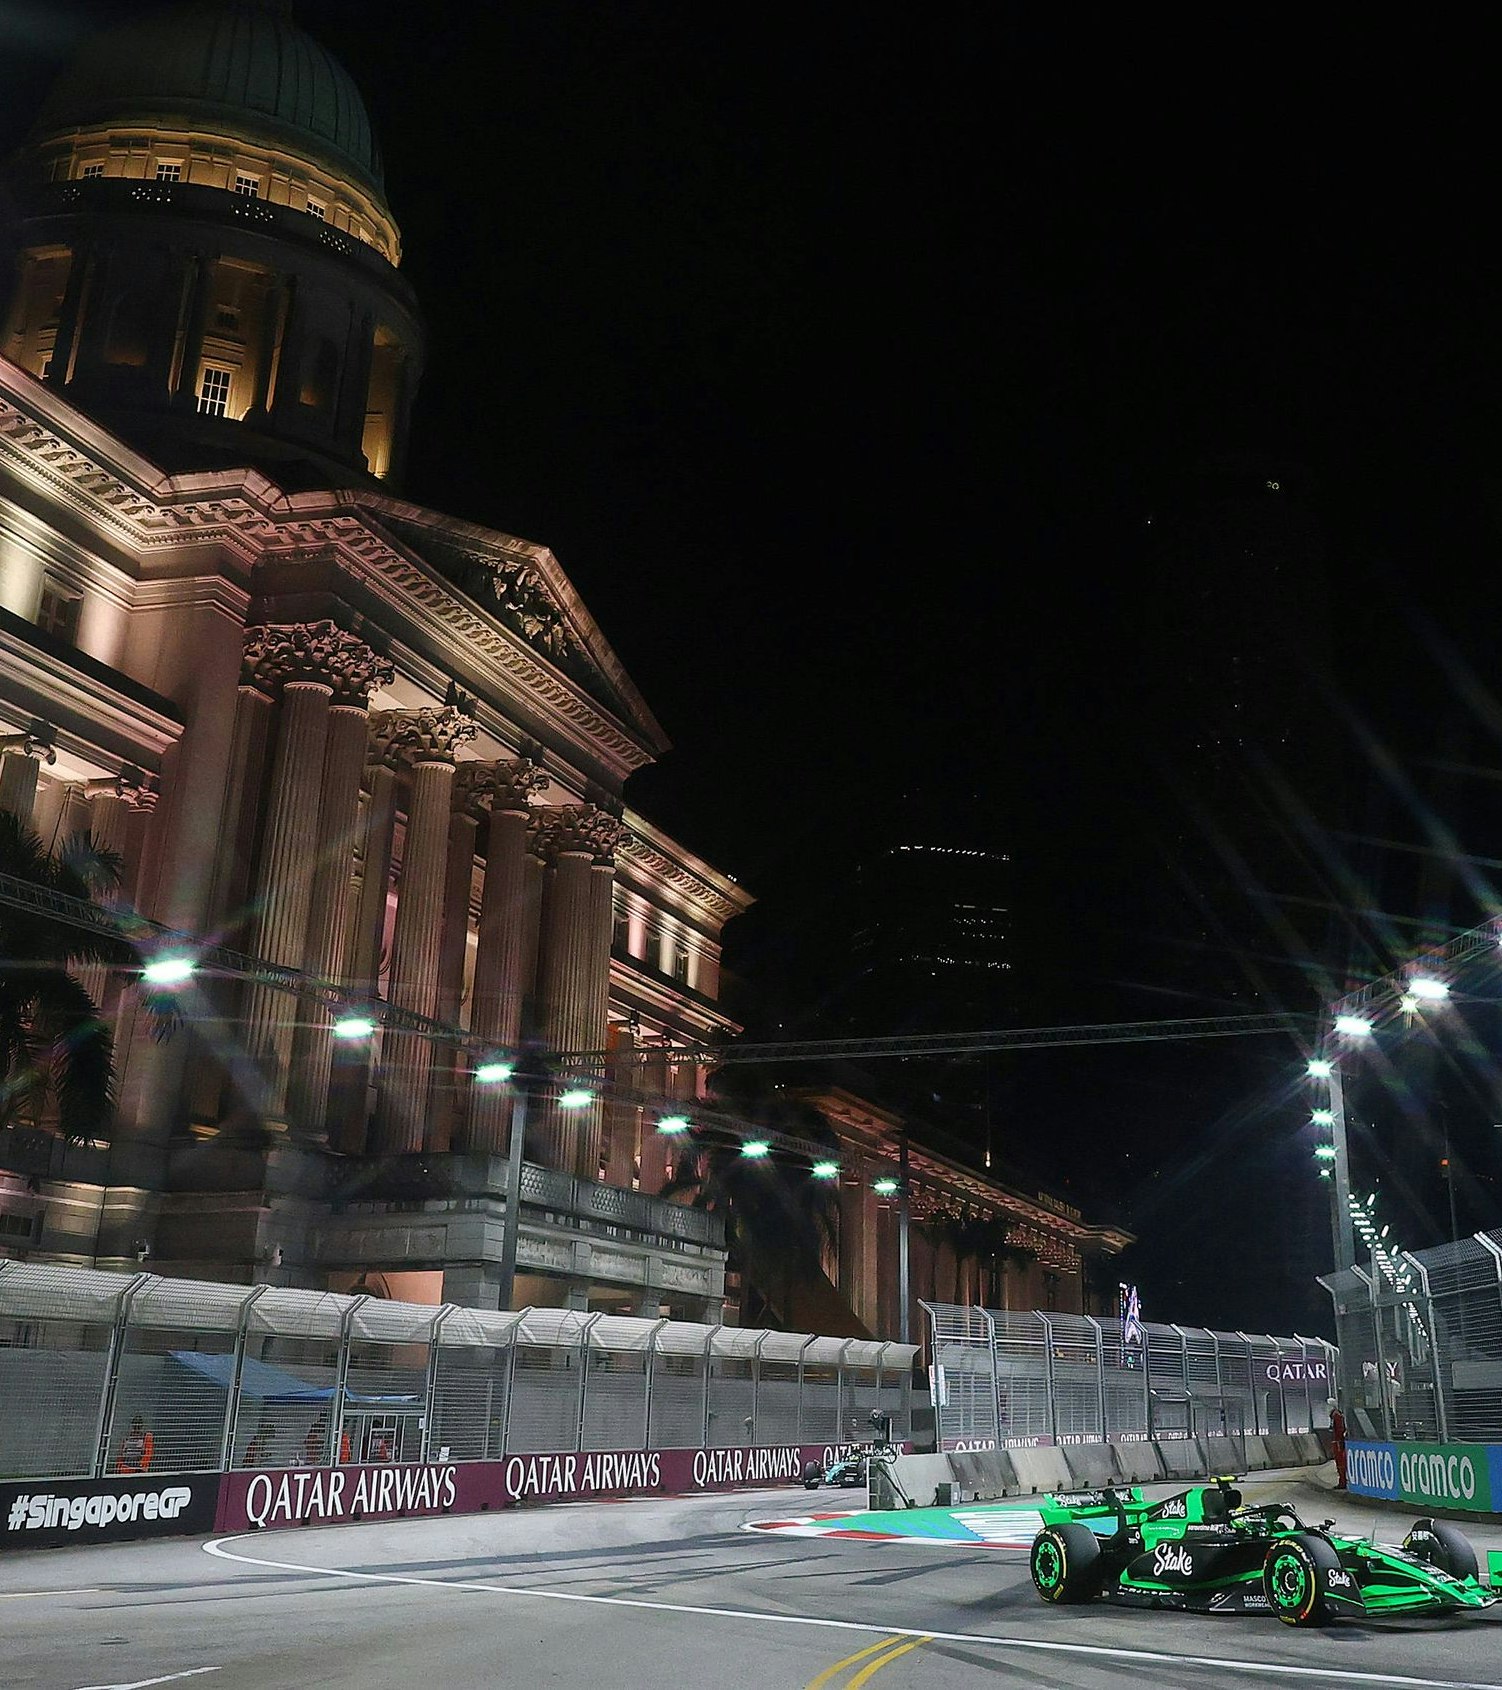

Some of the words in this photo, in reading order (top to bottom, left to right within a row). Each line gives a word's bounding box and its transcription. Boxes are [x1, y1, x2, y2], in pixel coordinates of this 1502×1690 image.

[1266, 1363, 1327, 1384] QATAR
[505, 1455, 578, 1500] QATAR
[581, 1452, 661, 1491] AIRWAYS
[693, 1450, 743, 1487] QATAR
[744, 1447, 800, 1479] AIRWAYS
[1346, 1442, 1394, 1490] aramco
[1400, 1445, 1475, 1500] aramco
[8, 1486, 192, 1531] #SingaporeGP
[246, 1471, 345, 1528] QATAR
[350, 1466, 457, 1514] AIRWAYS
[1162, 1499, 1186, 1519] Stake
[1153, 1542, 1193, 1577] Stake
[1328, 1568, 1351, 1588] Stake
[1243, 1595, 1267, 1603] MASCO
